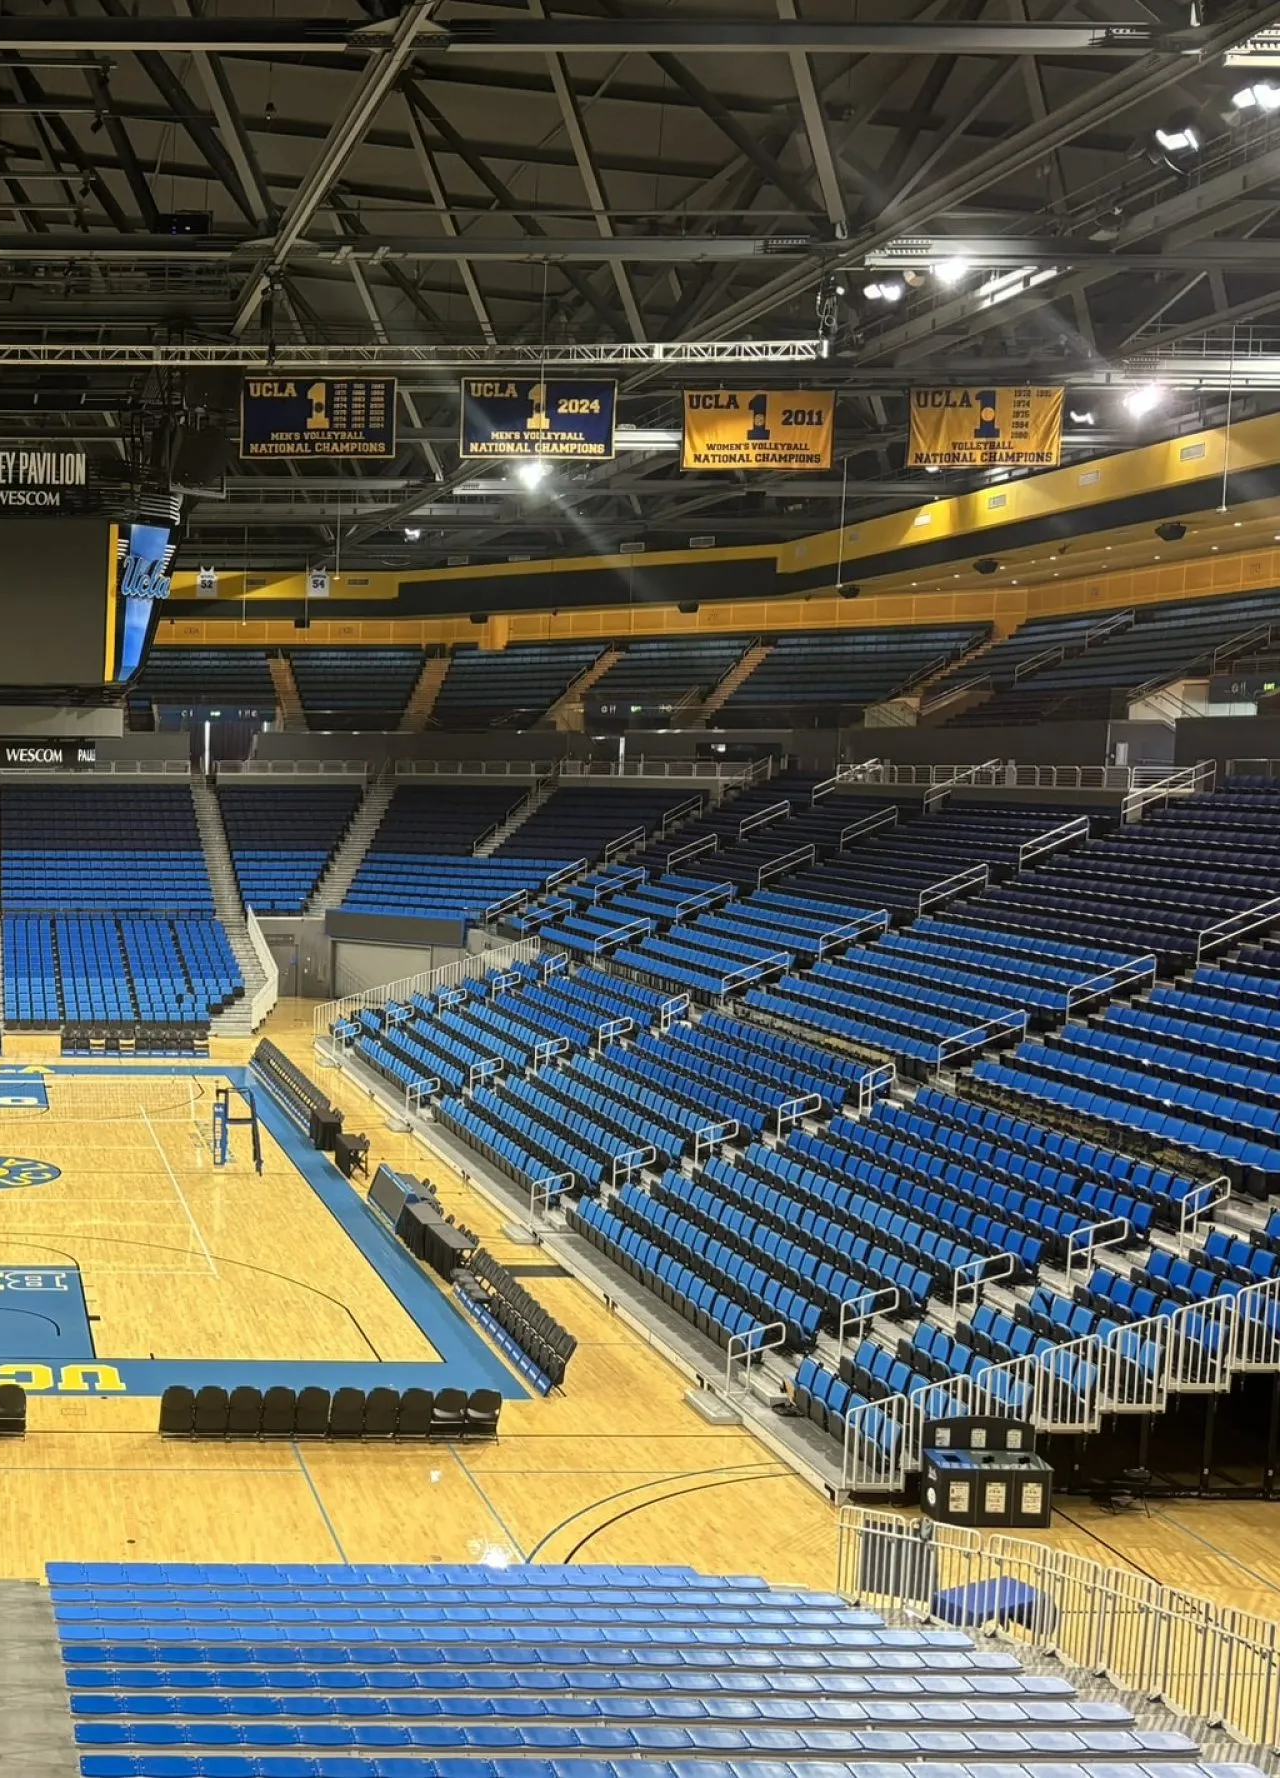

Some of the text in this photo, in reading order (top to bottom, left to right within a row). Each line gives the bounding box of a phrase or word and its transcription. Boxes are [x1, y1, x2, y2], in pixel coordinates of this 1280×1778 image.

[249, 382, 297, 397] UCLA
[471, 383, 518, 398] UCLA
[689, 394, 739, 409] UCLA
[915, 390, 972, 408] UCLA
[558, 399, 600, 414] 2024
[781, 410, 823, 425] 2011
[271, 431, 366, 440] MEN'S VOLLEYBALL
[491, 431, 585, 440] MEN'S VOLLEYBALL
[249, 442, 385, 453] NATIONAL CHAMPIONS
[470, 442, 605, 454] NATIONAL CHAMPIONS
[751, 442, 809, 450] VOLLEYBALL
[951, 441, 1014, 450] VOLLEYBALL
[693, 453, 821, 463] NATIONAL CHAMPIONS
[914, 452, 1052, 463] NATIONAL CHAMPIONS
[19, 452, 86, 485] PAVILION
[200, 579, 214, 589] 52
[312, 579, 326, 589] 54
[5, 748, 63, 762] WESCOM
